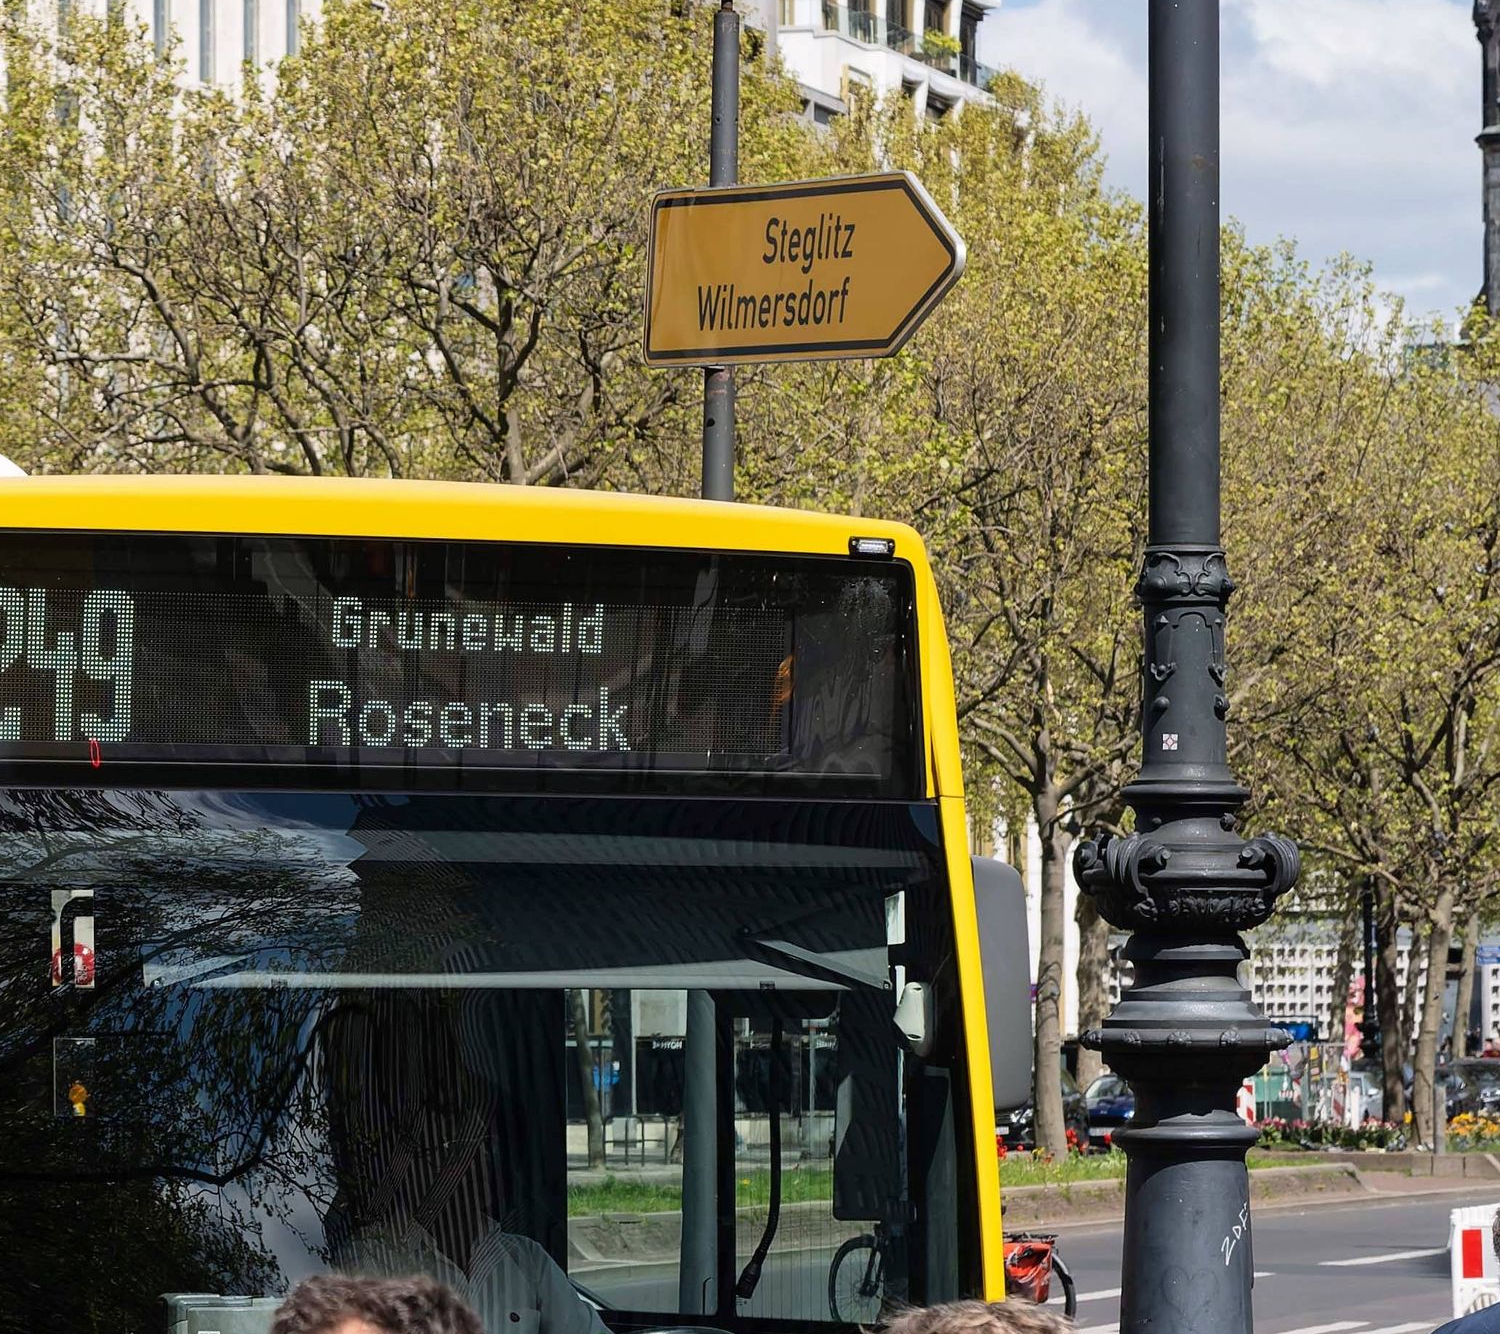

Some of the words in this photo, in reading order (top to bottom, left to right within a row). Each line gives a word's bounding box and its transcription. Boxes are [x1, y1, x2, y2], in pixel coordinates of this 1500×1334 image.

[762, 213, 856, 274] Steglitz
[697, 277, 851, 332] Wilmersdorf
[331, 595, 604, 655] Grunewald
[308, 678, 633, 752] Roseneck
